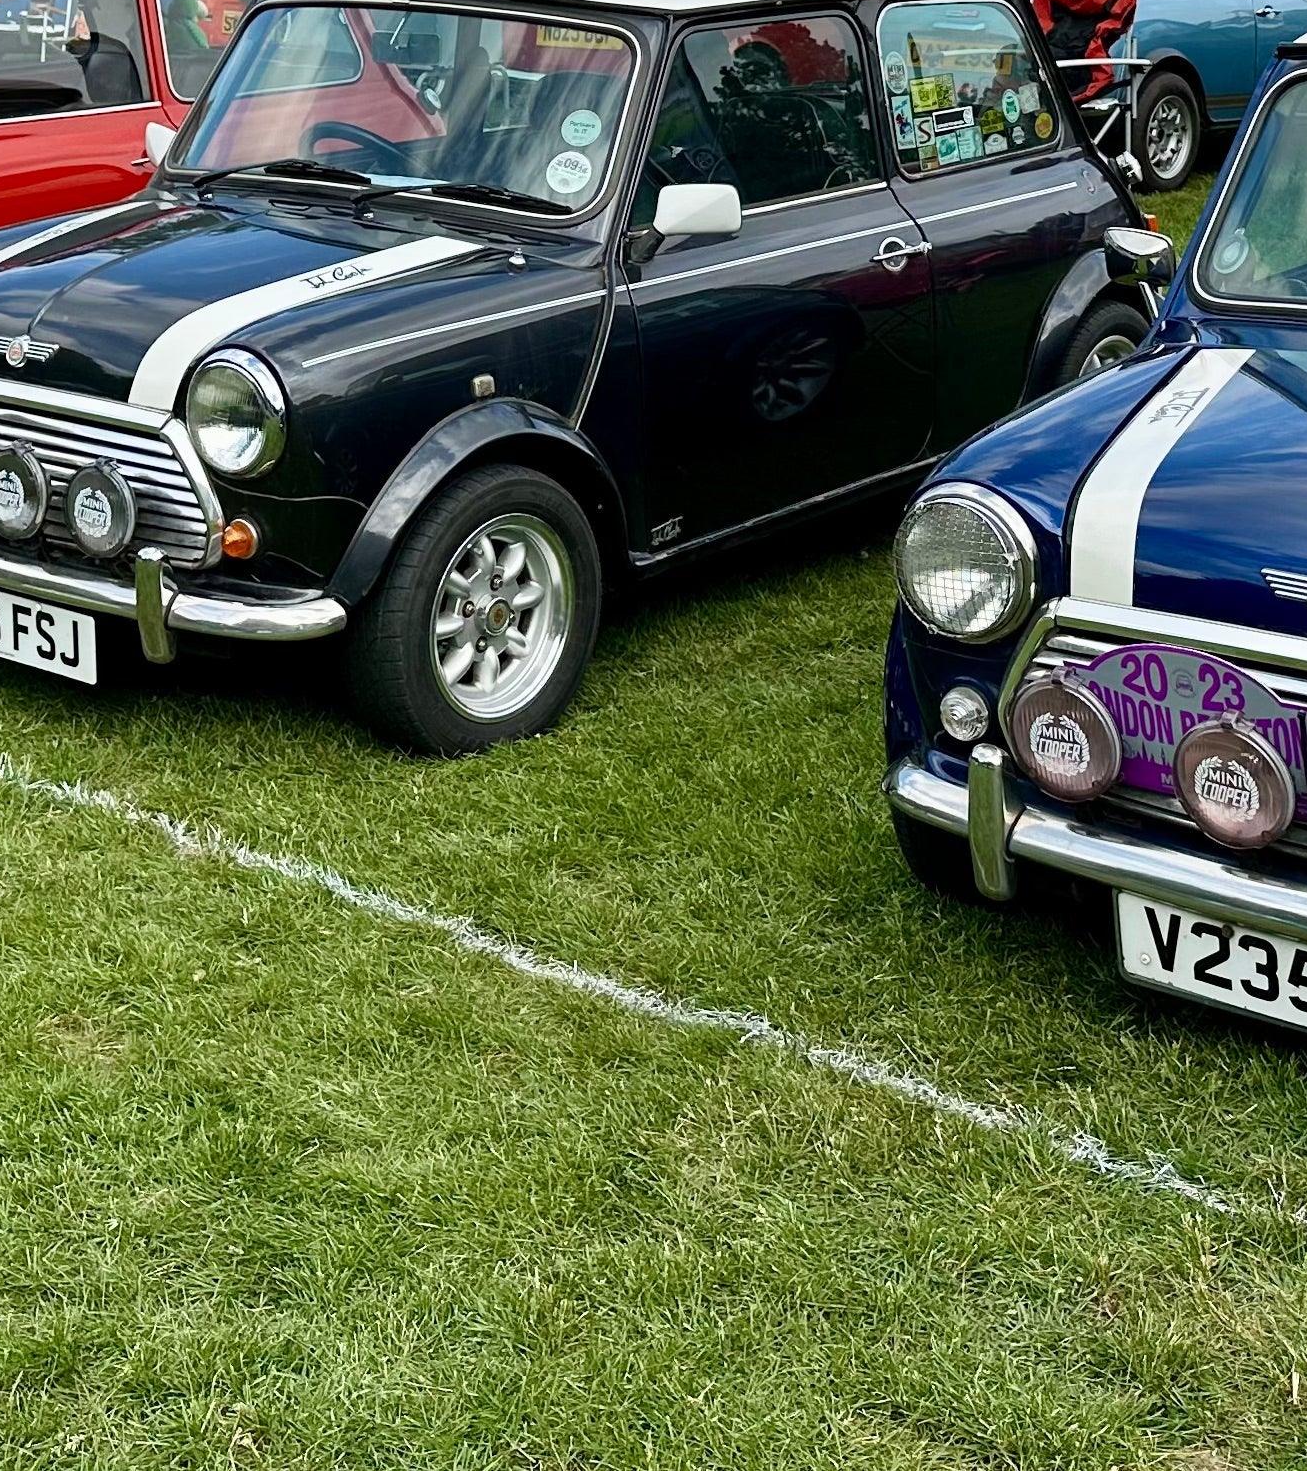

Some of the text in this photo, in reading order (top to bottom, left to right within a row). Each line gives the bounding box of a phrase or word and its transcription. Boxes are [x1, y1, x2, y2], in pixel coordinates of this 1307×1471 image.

[82, 496, 105, 512] MINI
[12, 603, 80, 668] FSJ
[1120, 653, 1245, 713] 20 23
[1040, 725, 1076, 742] MINI
[1036, 740, 1082, 764] COOPER
[1208, 767, 1245, 790] MINI
[1201, 781, 1252, 809] COOPER
